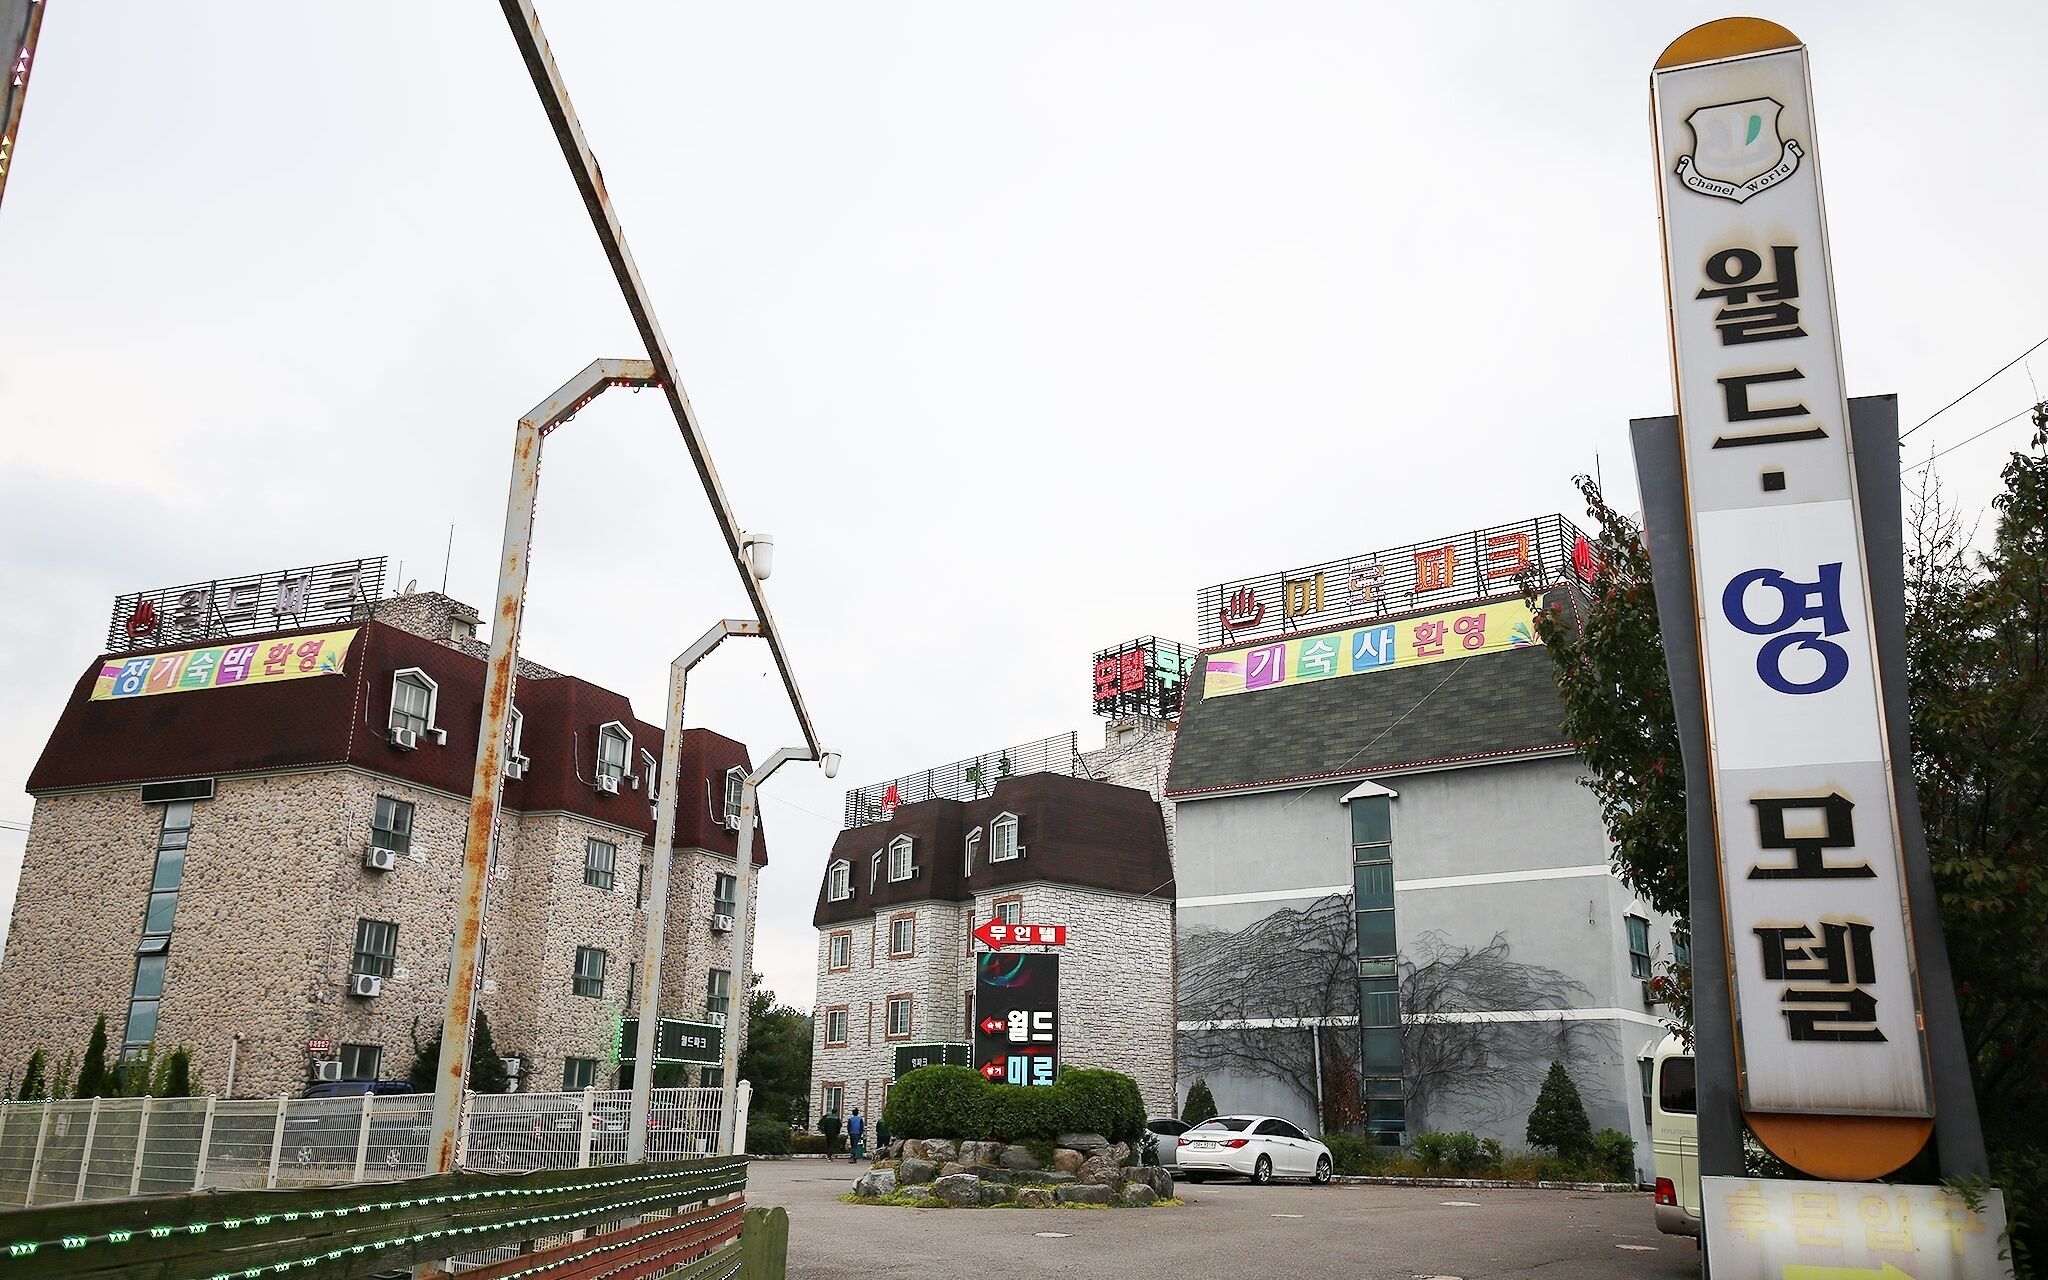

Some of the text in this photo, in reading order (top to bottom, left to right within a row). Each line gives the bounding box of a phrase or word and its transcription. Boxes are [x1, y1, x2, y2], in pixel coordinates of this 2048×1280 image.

[1688, 163, 1790, 196] Chanel World
[174, 569, 362, 631] 월드파크
[121, 640, 325, 694] 장기숙박 환영
[1250, 613, 1487, 682] 기숙사 환영
[1747, 792, 1889, 1043] 모텔
[1007, 1010, 1053, 1042] 월드
[1007, 1056, 1053, 1087] 미로
